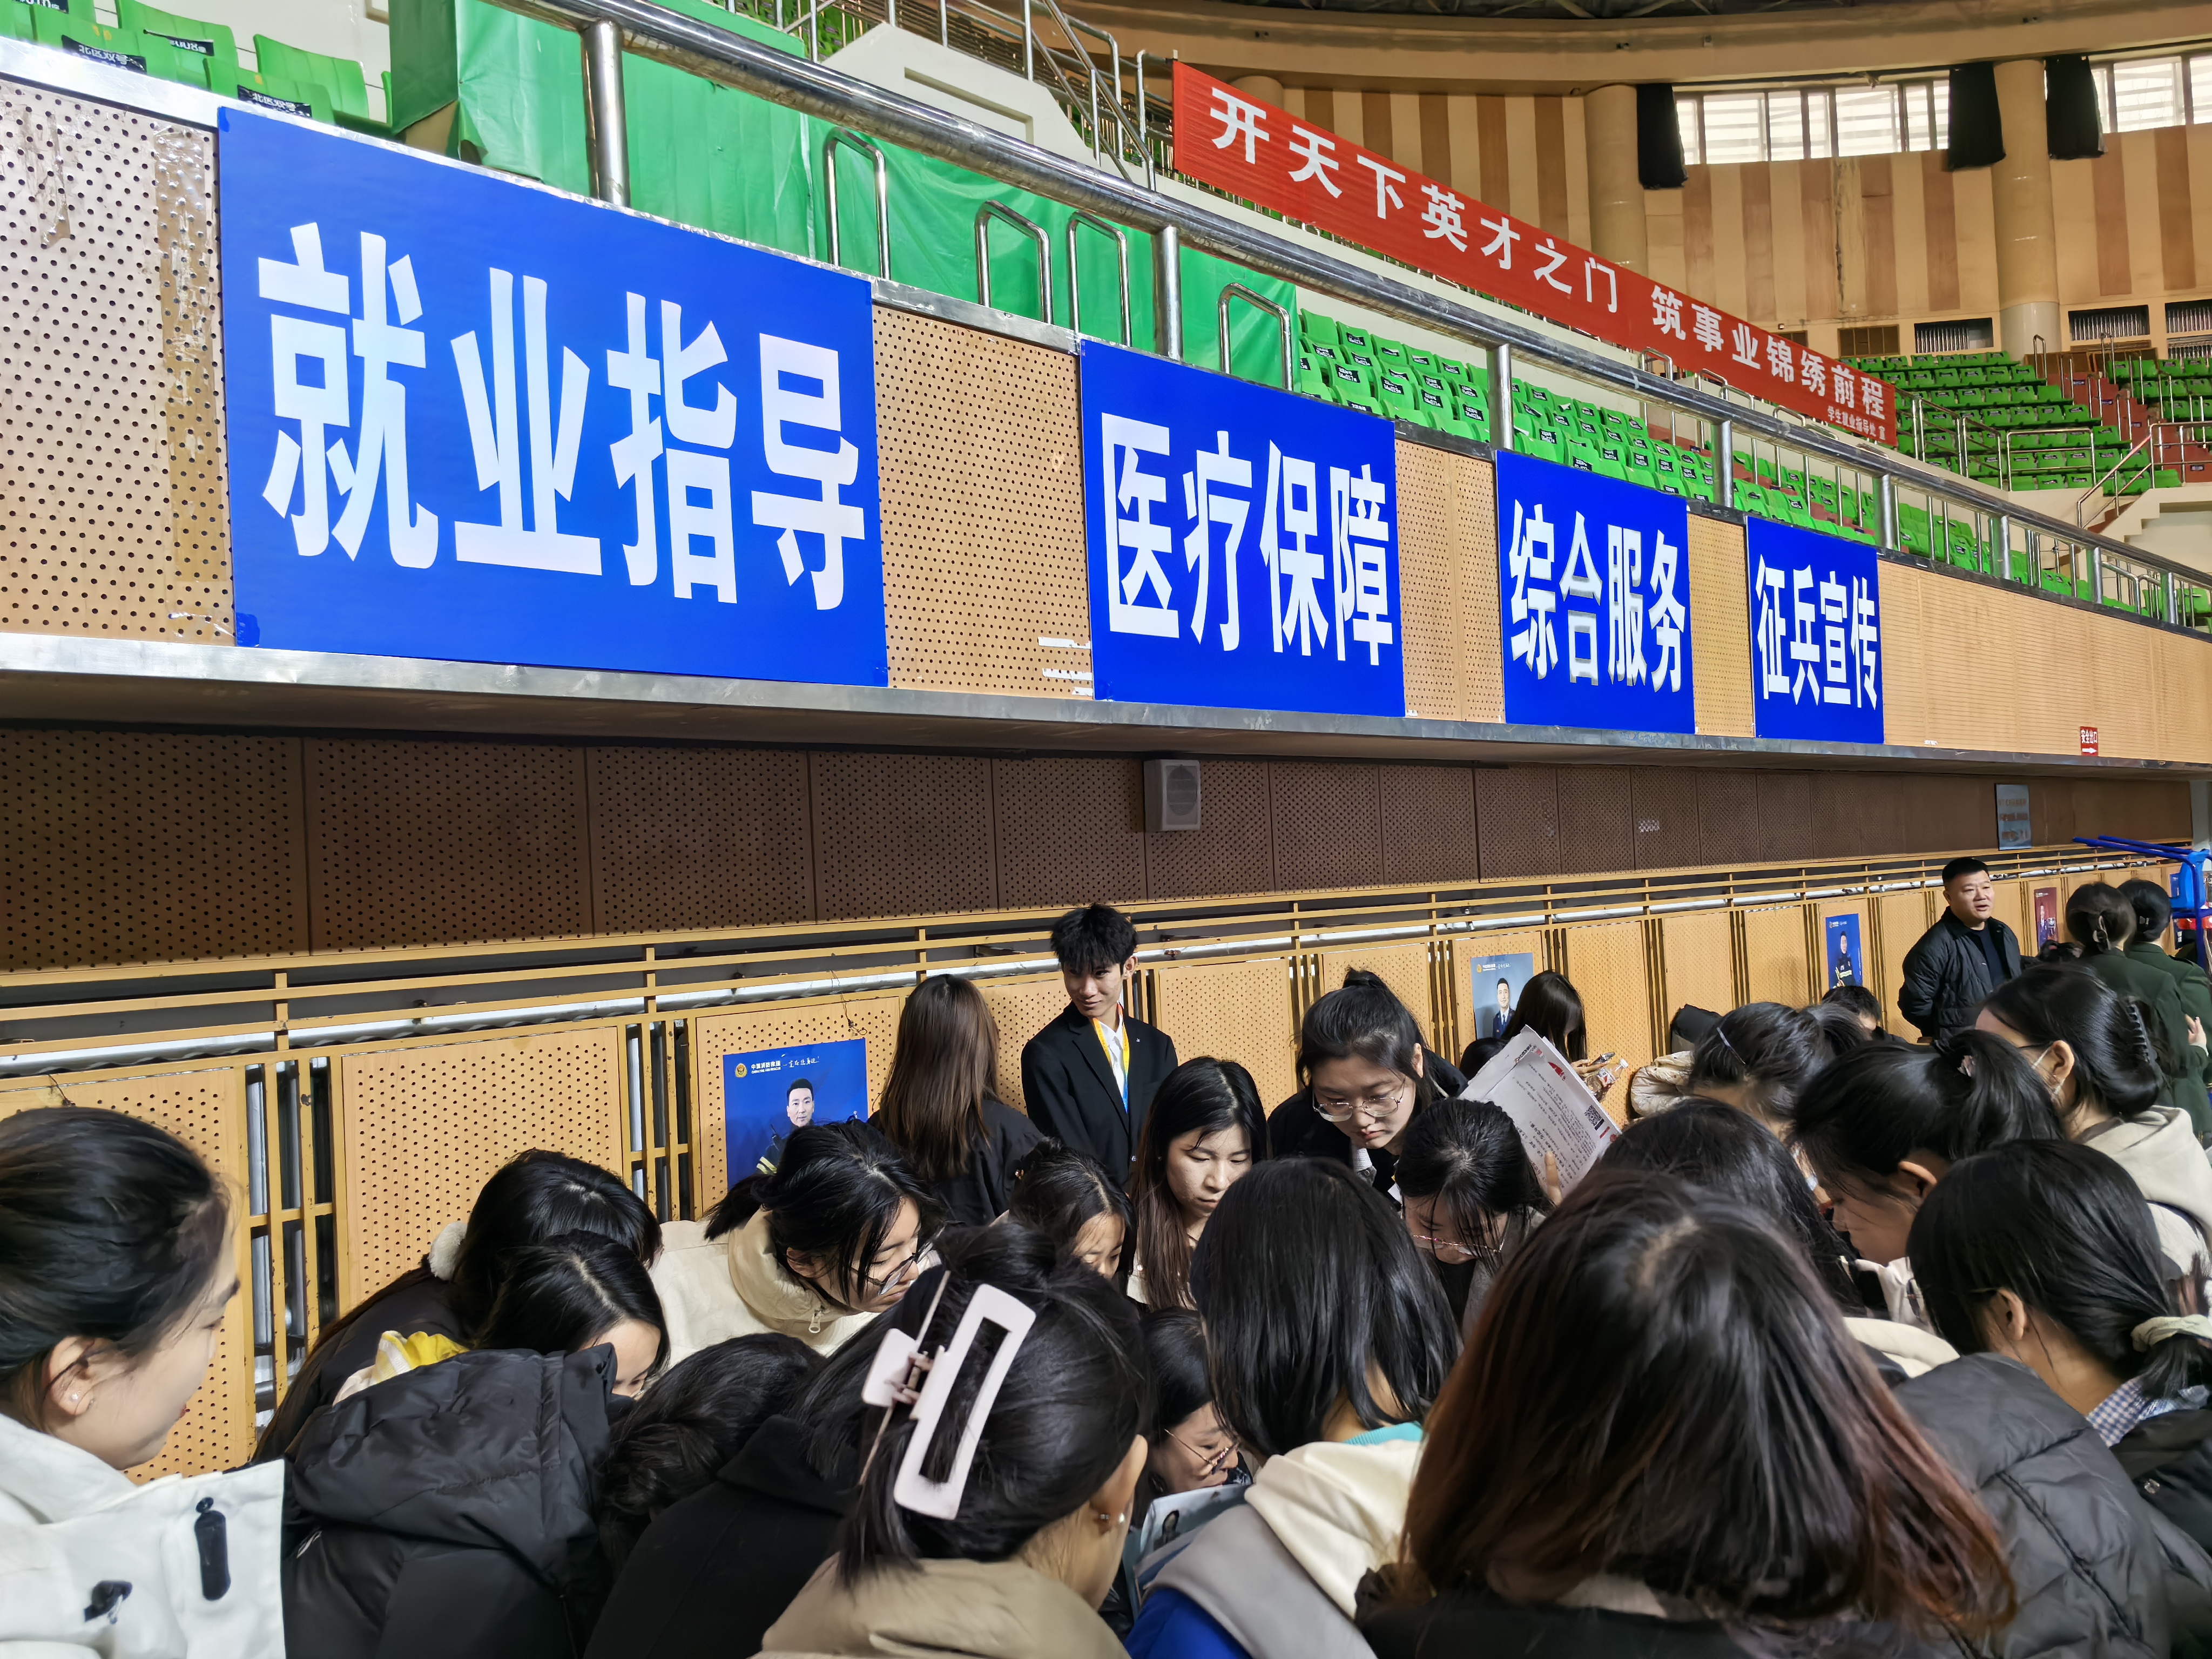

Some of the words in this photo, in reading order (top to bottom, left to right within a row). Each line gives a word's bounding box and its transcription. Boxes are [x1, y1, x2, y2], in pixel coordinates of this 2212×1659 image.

[1210, 87, 1618, 313] 开天下英才之门
[1650, 284, 1886, 420] 筑事业锦绣前程
[258, 222, 865, 610] 就业指导
[1101, 413, 1394, 666] 医疗保障
[1509, 499, 1686, 693] 综合服务
[1755, 555, 1879, 711] 征兵宣传
[2081, 729, 2098, 744] 安全出口
